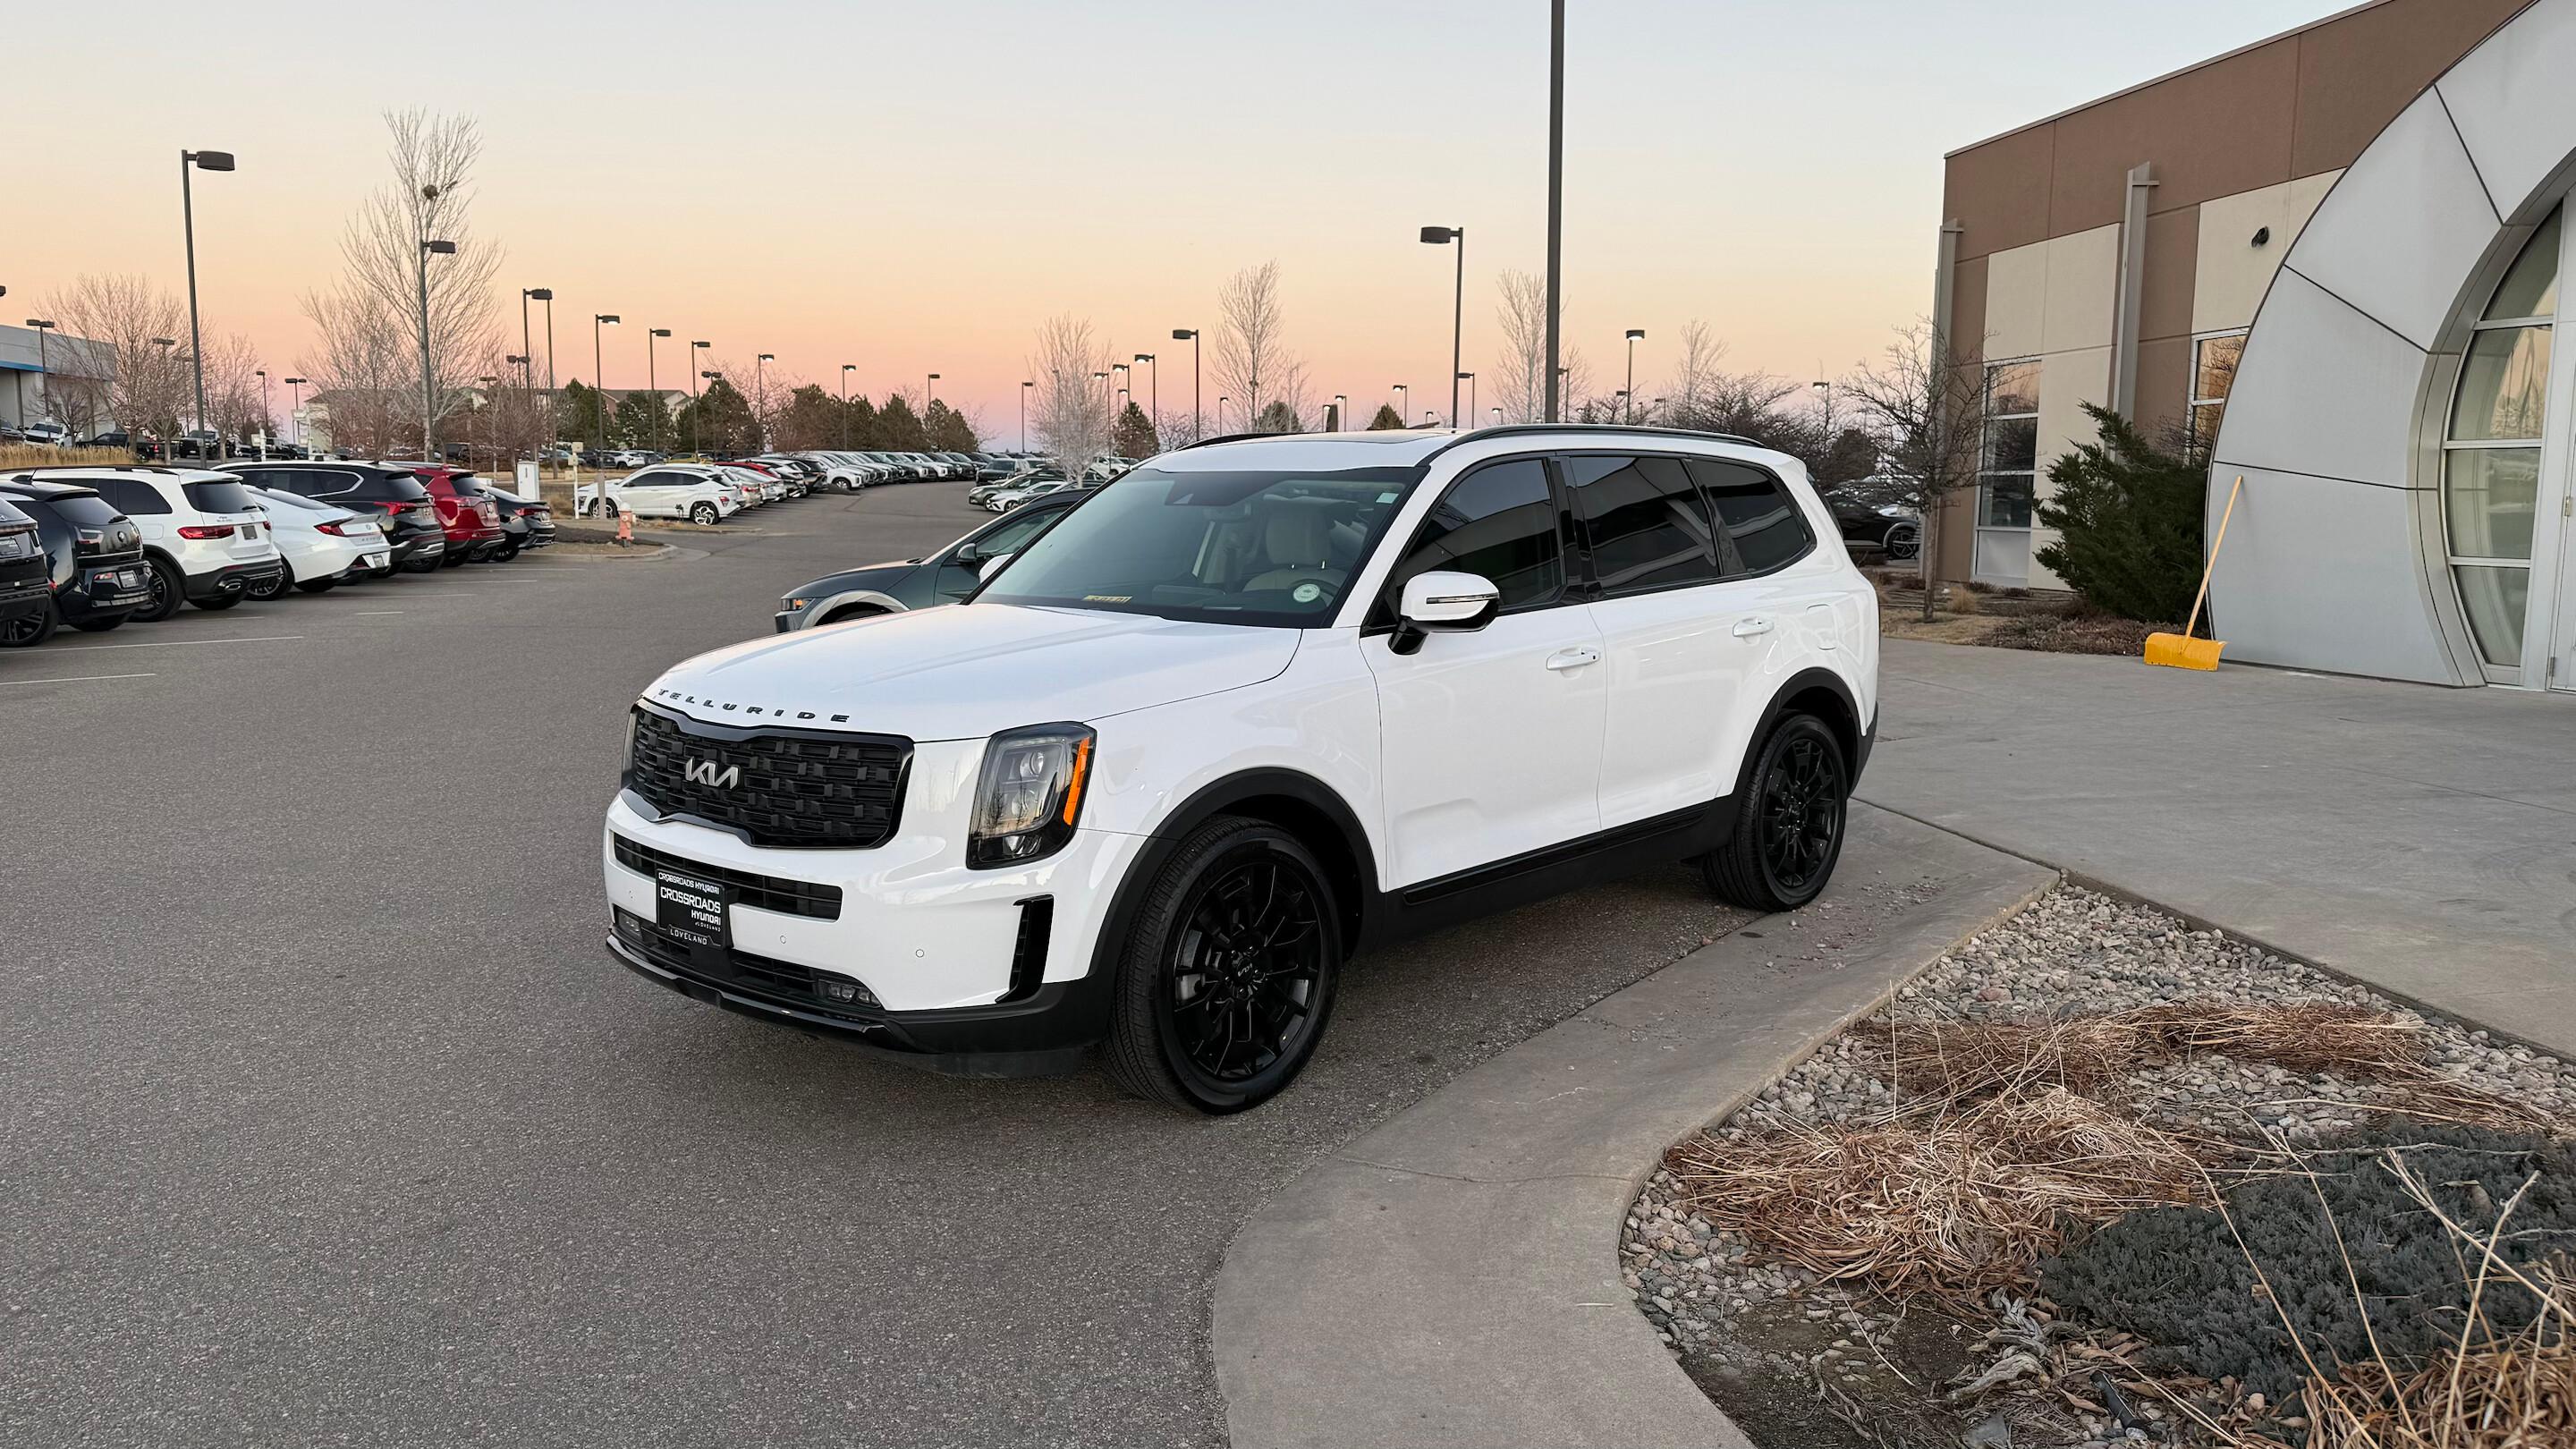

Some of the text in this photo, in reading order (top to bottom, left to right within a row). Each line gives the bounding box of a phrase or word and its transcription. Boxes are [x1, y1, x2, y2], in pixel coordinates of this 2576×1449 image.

[658, 689, 850, 723] TELLURIDE
[685, 757, 739, 790] KIA
[658, 872, 694, 888] CROSSROADS
[660, 886, 721, 914] CROSSROADS
[691, 909, 721, 926] HYUNDAI
[670, 928, 708, 945] LOVELAND
